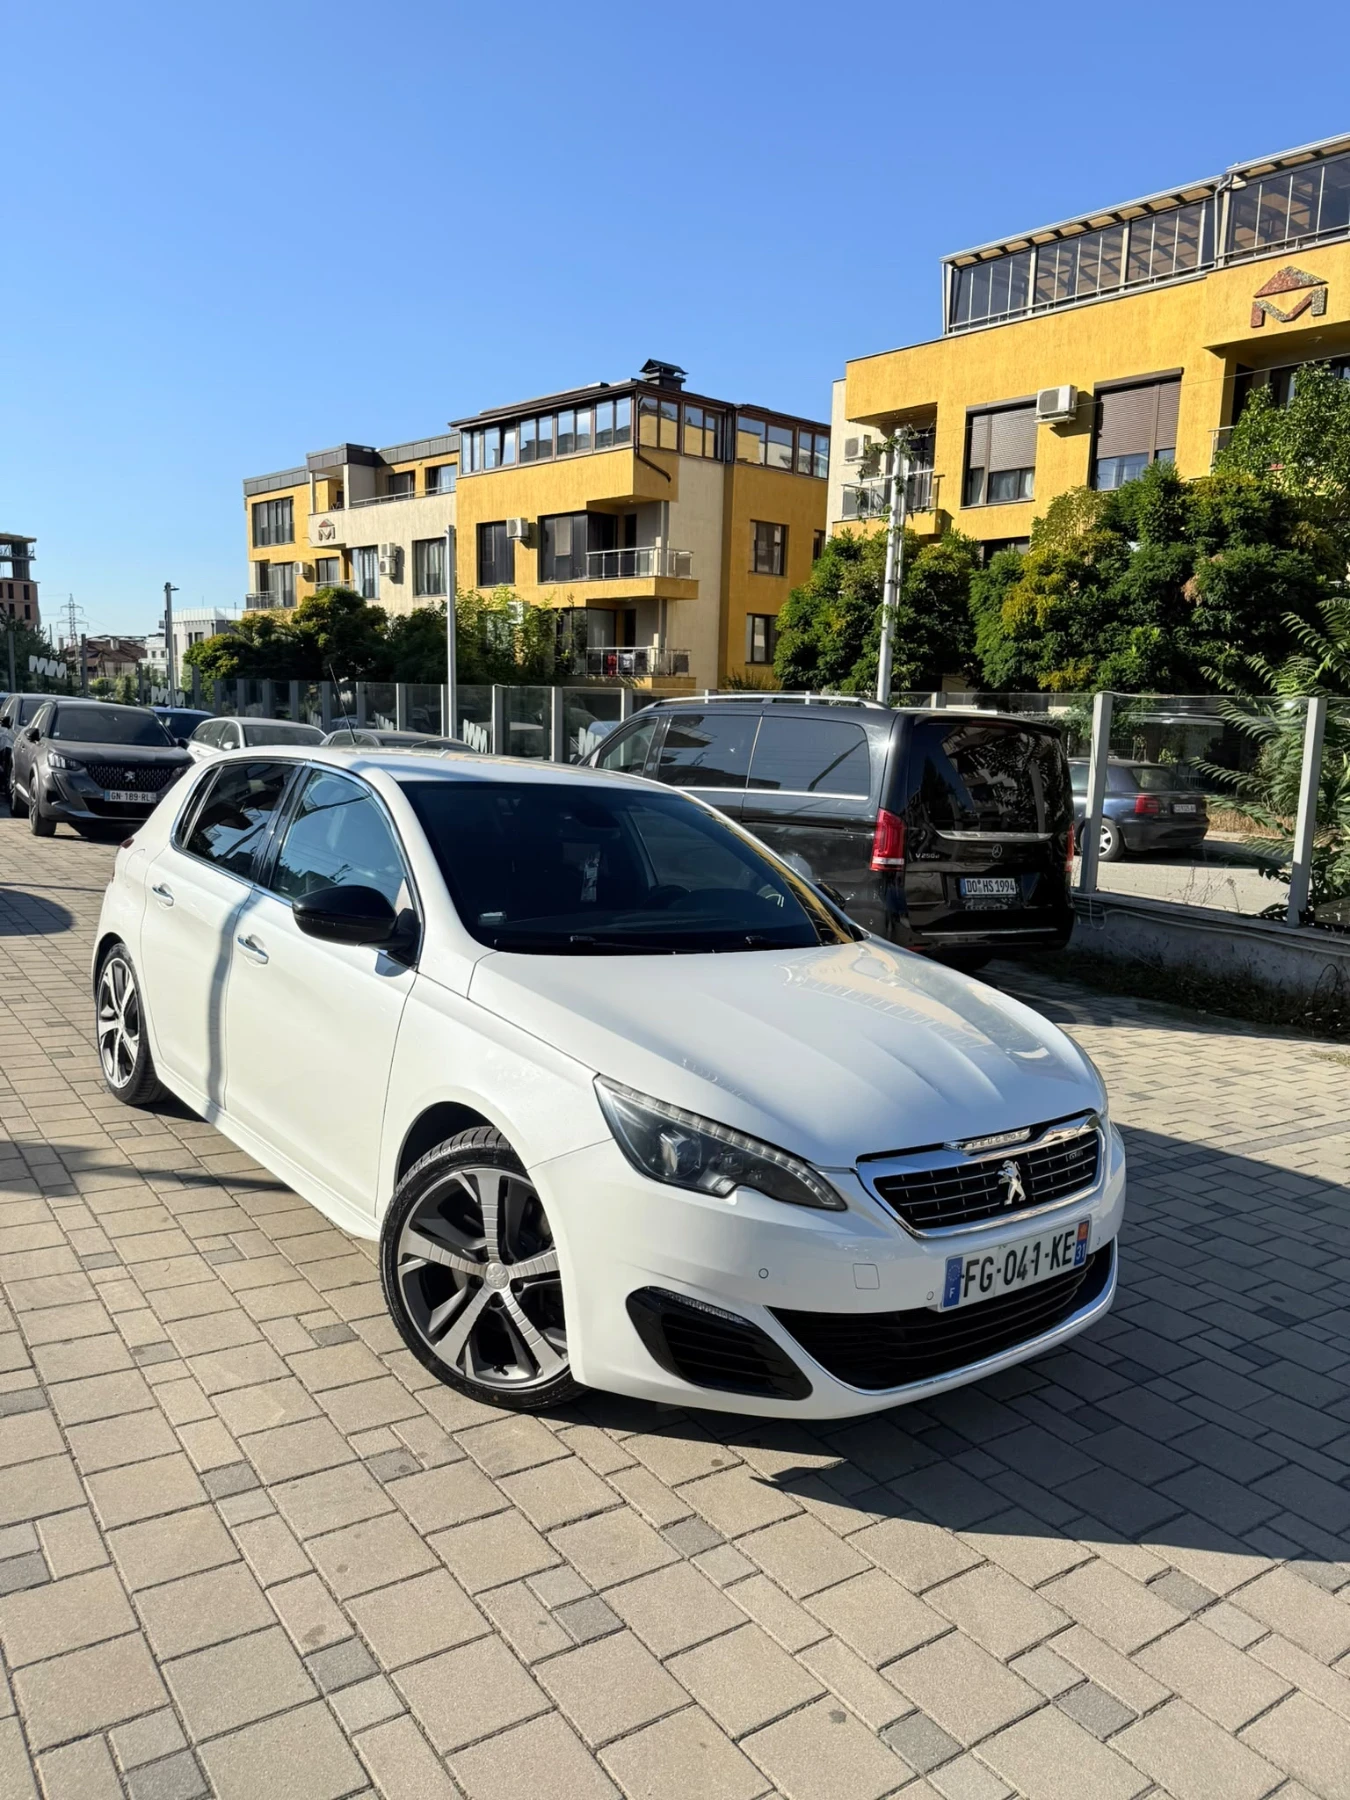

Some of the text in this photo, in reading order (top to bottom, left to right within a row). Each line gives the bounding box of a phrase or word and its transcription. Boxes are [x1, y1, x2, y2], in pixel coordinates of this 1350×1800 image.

[996, 879, 1016, 893] 1994
[971, 1131, 1024, 1148] PEUGEOT
[962, 1229, 1076, 1298] FG-041-KE
[1075, 1243, 1087, 1261] 31
